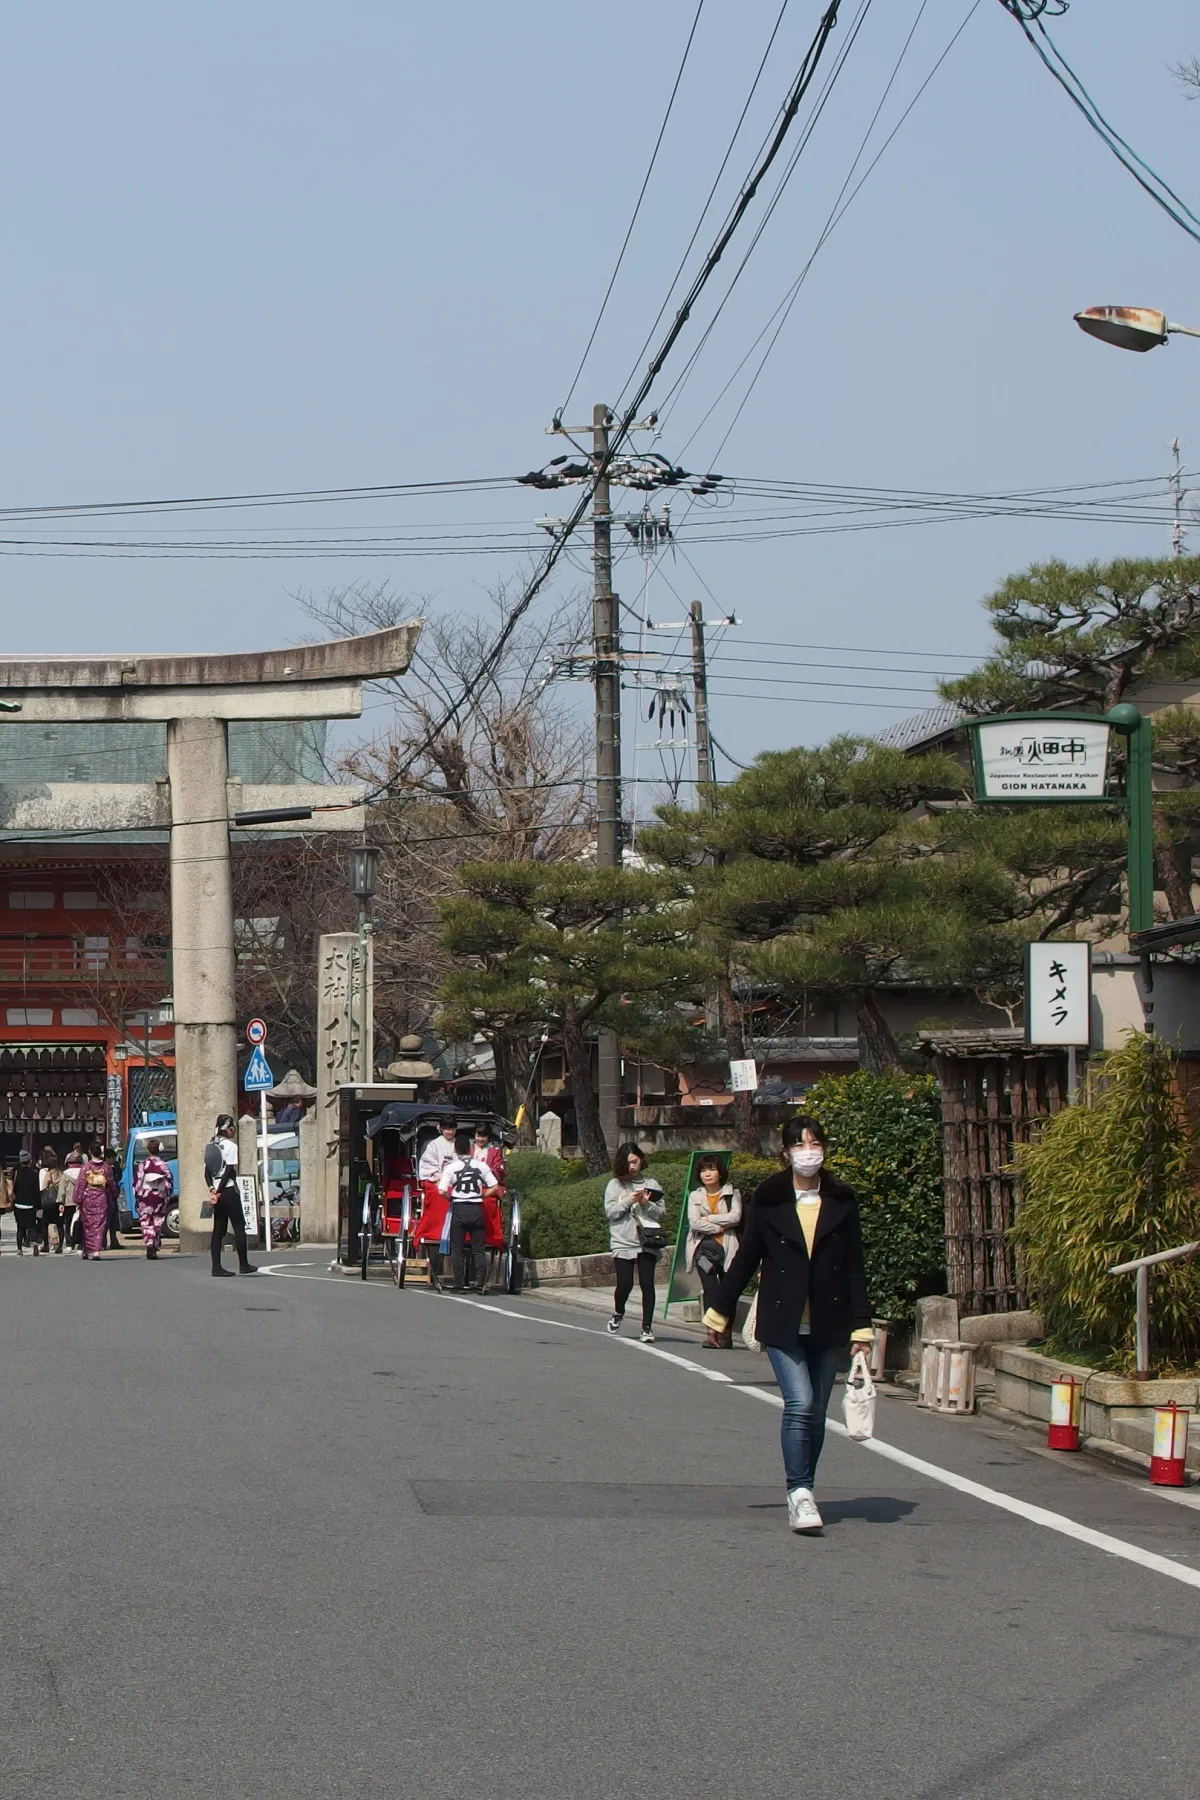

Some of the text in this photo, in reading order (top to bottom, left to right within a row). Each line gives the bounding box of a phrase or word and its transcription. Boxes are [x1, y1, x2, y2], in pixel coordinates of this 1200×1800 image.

[1001, 782, 1087, 790] GION HATANAKA
[324, 947, 347, 999] 大社
[1047, 960, 1068, 1026] キメラ
